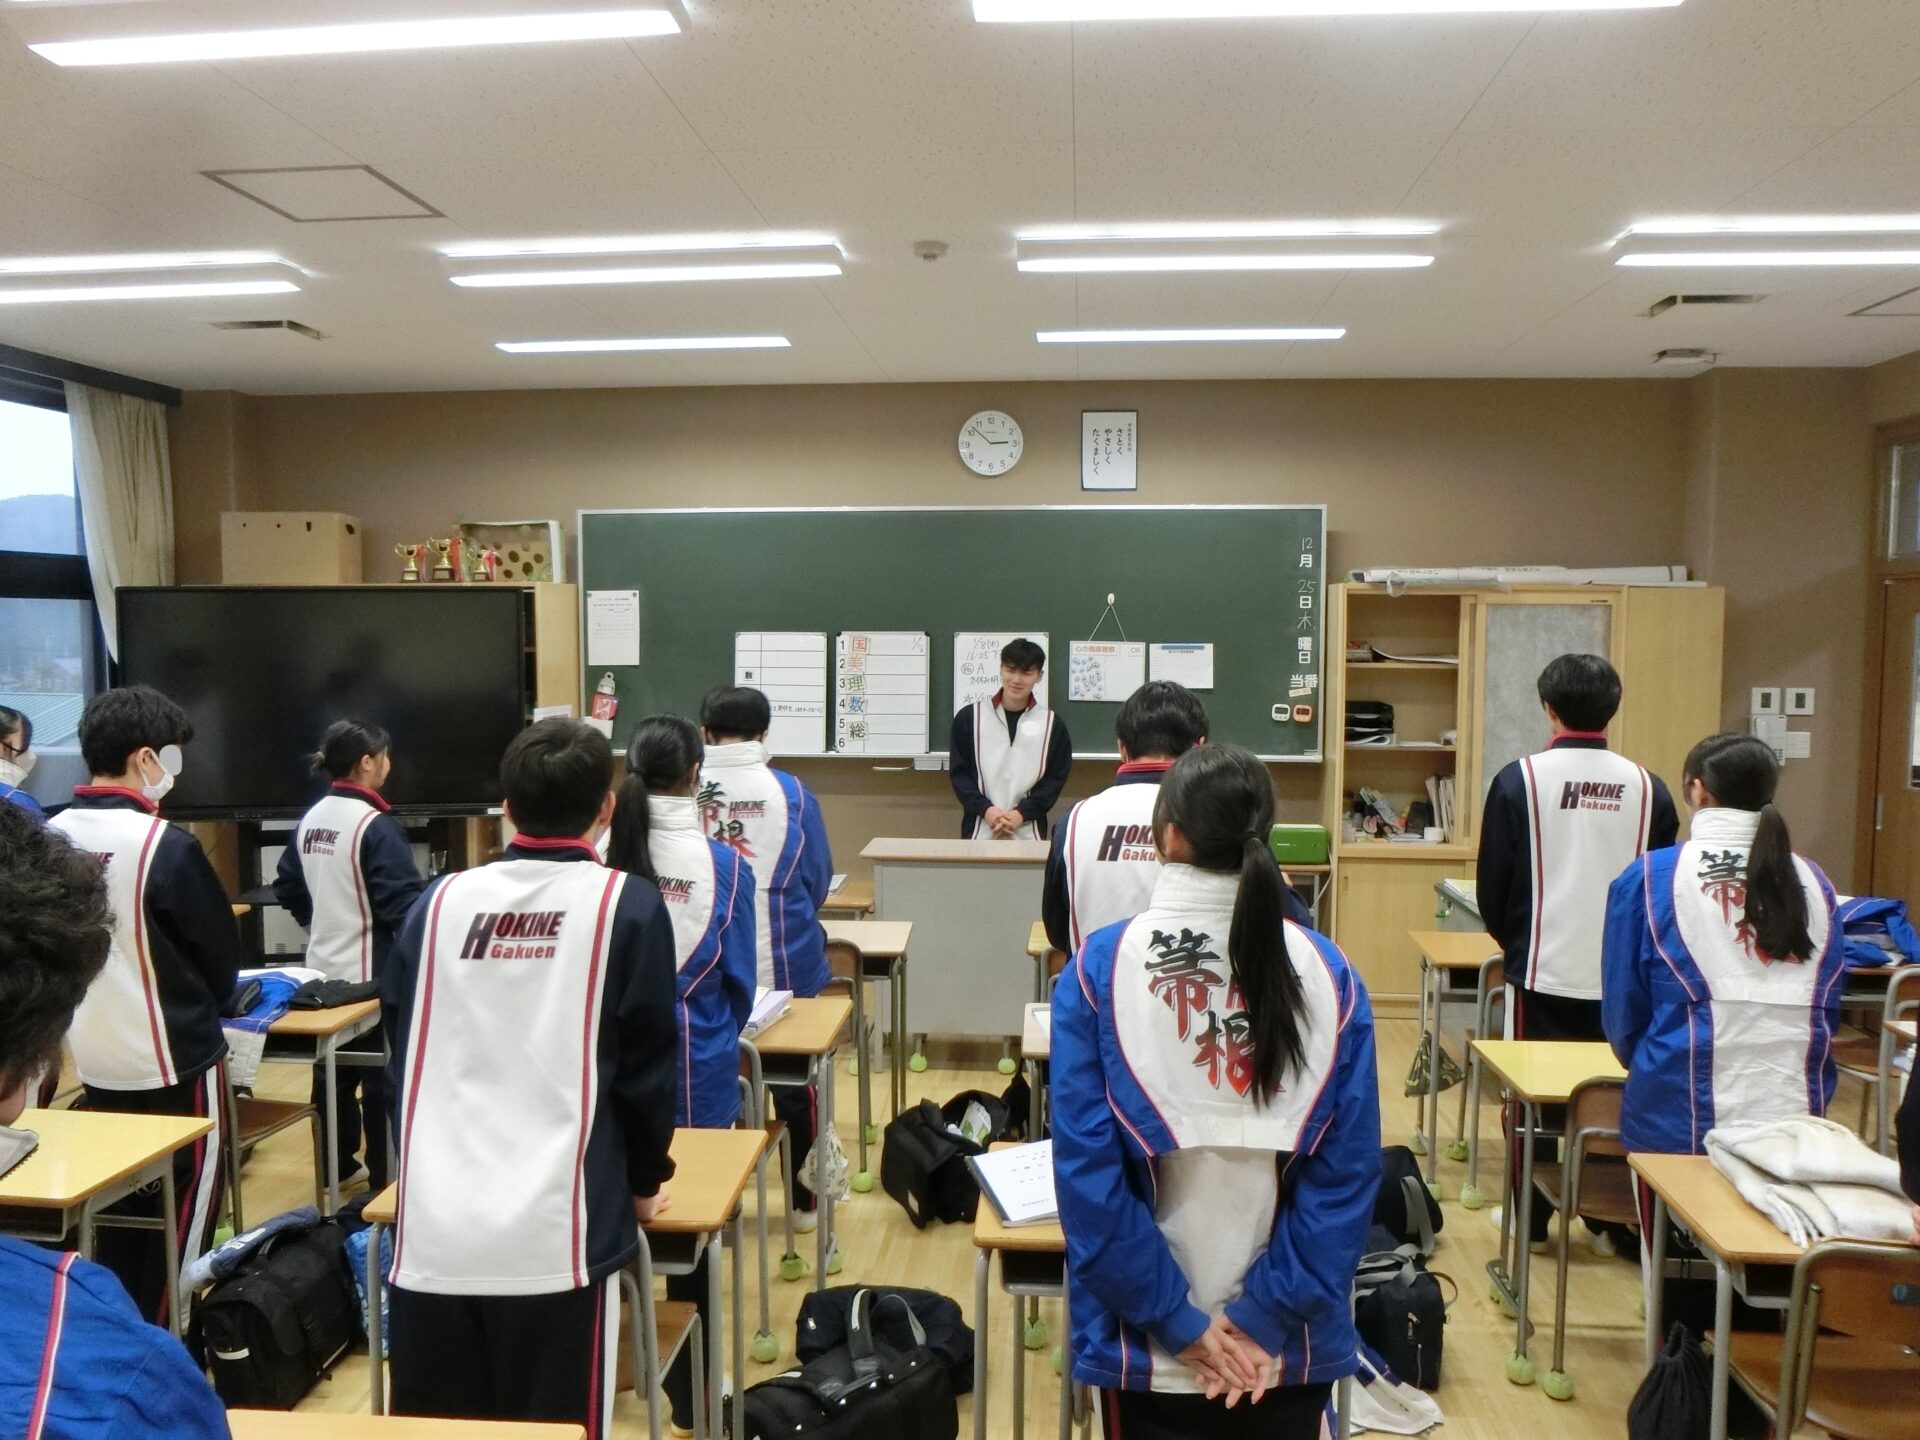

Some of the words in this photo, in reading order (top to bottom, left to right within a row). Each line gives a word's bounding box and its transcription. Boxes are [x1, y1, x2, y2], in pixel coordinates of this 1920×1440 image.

[840, 640, 844, 650] 1
[840, 660, 844, 668] 2
[848, 676, 864, 690] 理
[1290, 674, 1318, 688] 当番
[840, 699, 845, 708] 4
[848, 696, 864, 712] 数
[840, 719, 844, 728] 5
[838, 738, 845, 748] 6
[1560, 782, 1626, 809] HOKINE
[1580, 800, 1620, 812] Gakuen
[1096, 825, 1153, 861] HOK
[1122, 848, 1156, 861] Gaku
[656, 876, 696, 896] OKINE
[460, 911, 567, 960] HOKINE
[490, 943, 556, 960] Gakuen
